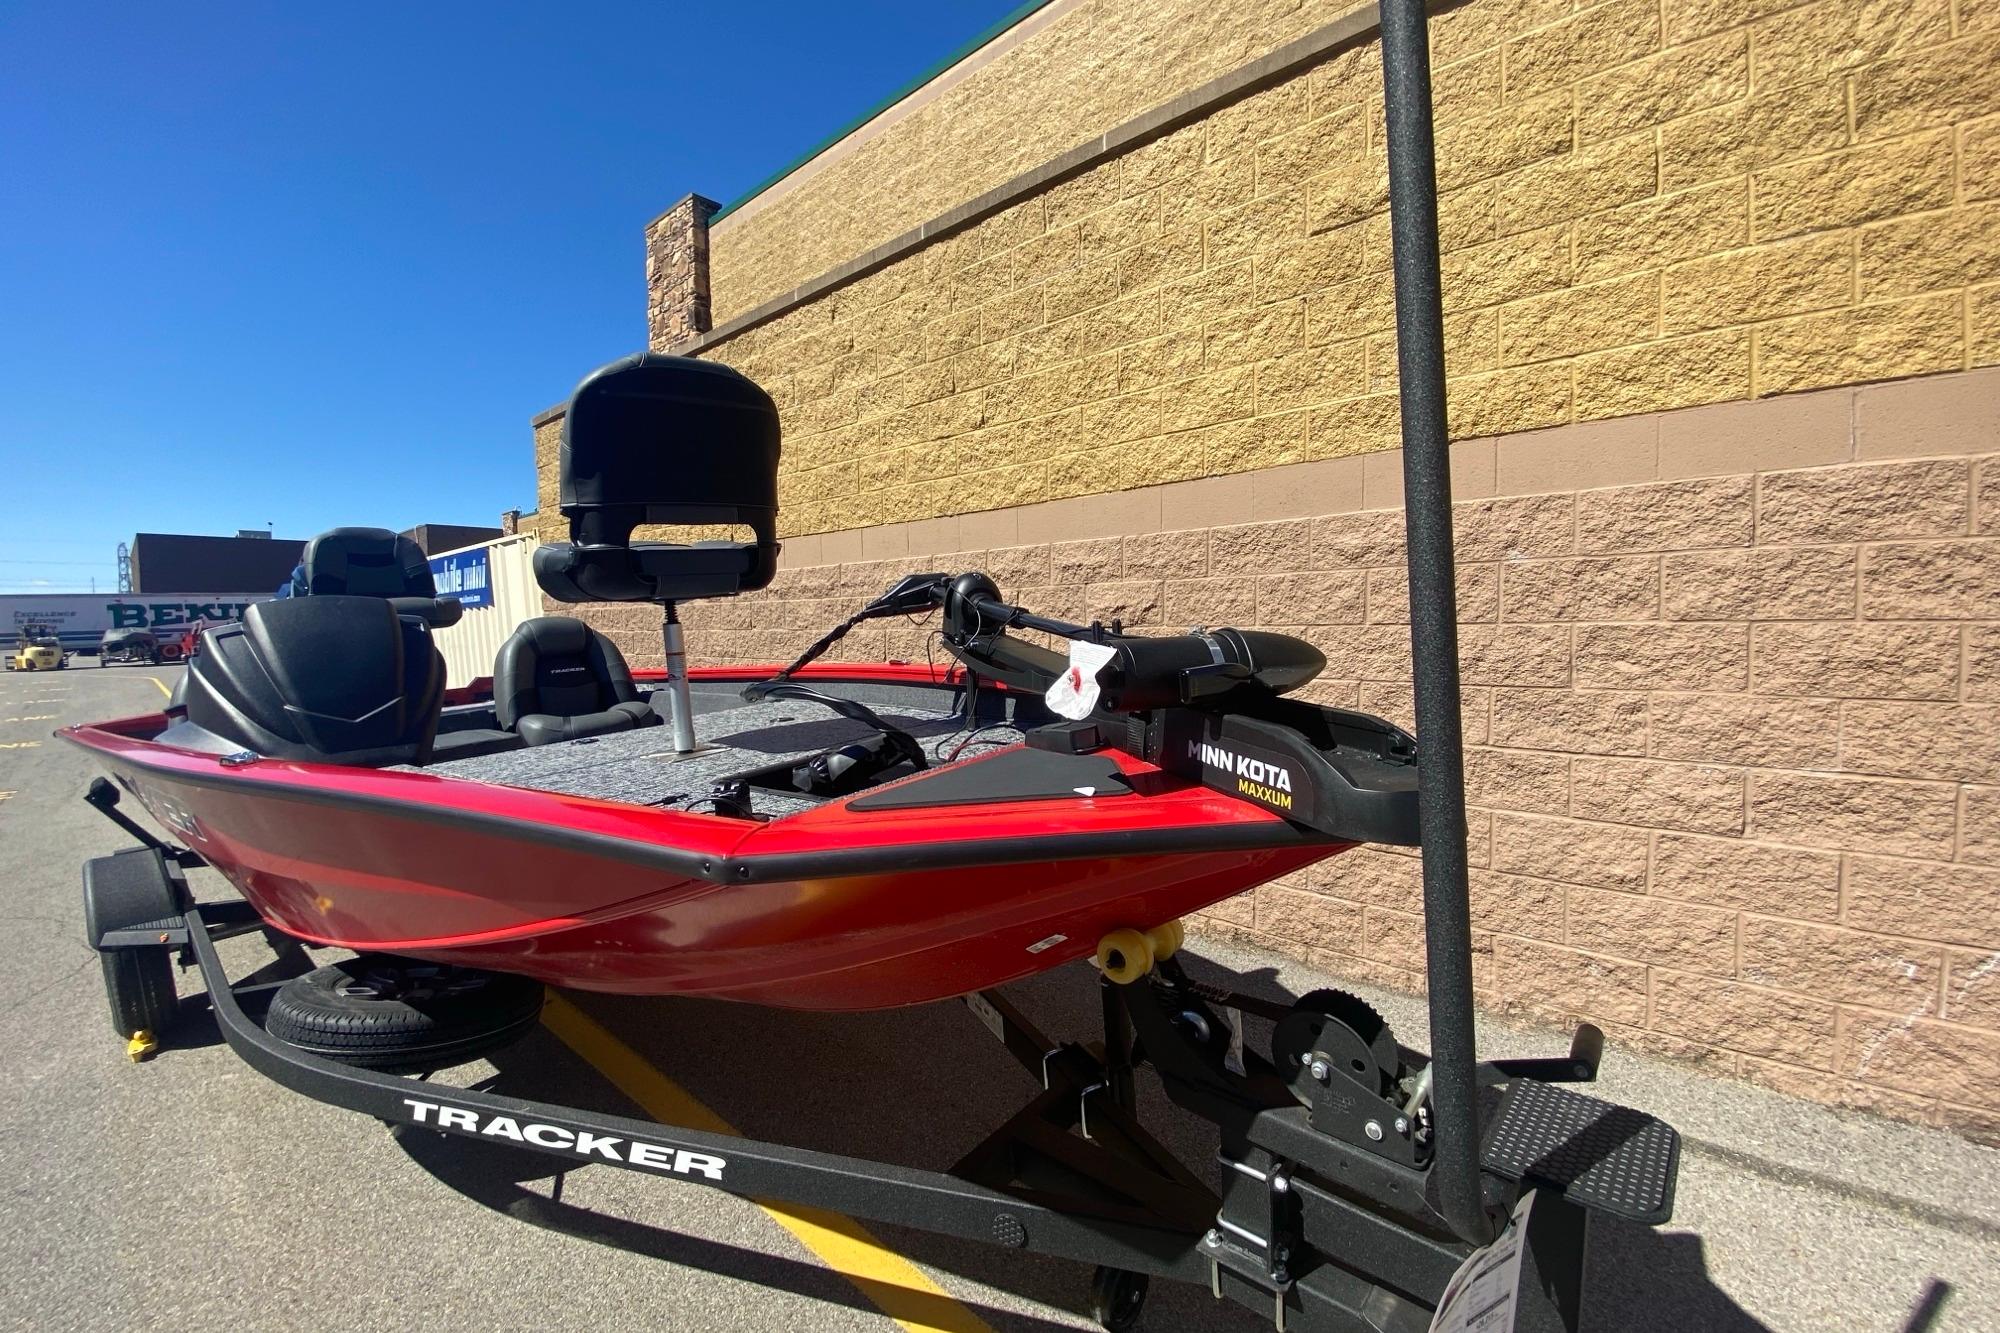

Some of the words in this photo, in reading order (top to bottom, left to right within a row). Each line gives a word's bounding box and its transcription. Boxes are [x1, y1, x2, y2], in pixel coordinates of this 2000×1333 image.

[463, 557, 486, 591] mini
[1188, 740, 1233, 772] MINN
[1236, 755, 1292, 792] KOTA
[1238, 778, 1292, 810] MAXXUM
[403, 1099, 727, 1181] TRACKER
